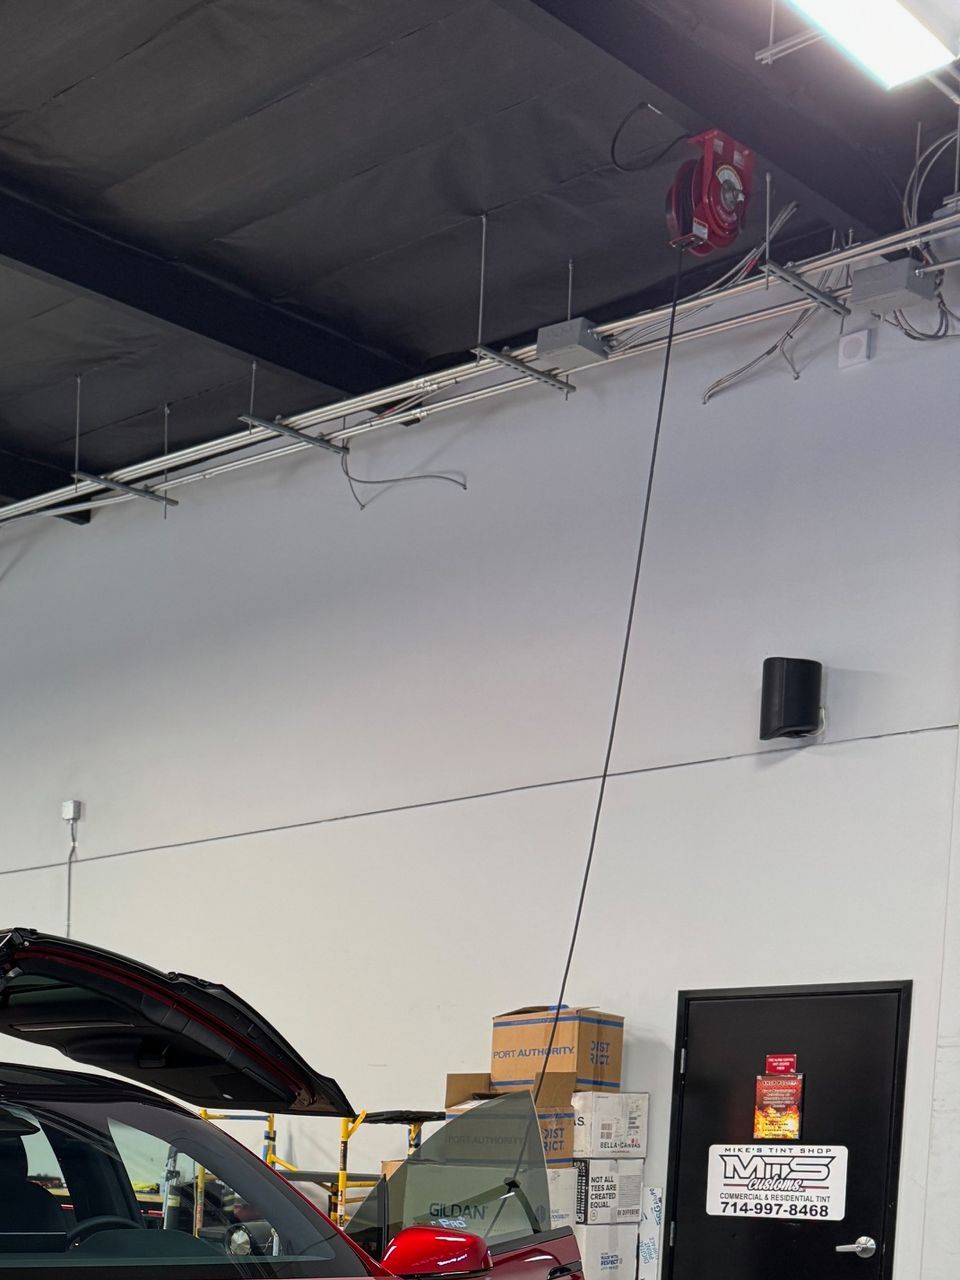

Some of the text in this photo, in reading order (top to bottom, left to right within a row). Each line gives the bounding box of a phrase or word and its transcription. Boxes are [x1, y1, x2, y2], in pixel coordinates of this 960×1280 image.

[493, 1050, 516, 1060] PORT
[448, 1136, 470, 1144] PORT
[747, 1174, 803, 1192] customs
[770, 1194, 814, 1202] RESIDENTIAL
[430, 1202, 486, 1220] GILDAN
[720, 1202, 828, 1217] 714-997-8468
